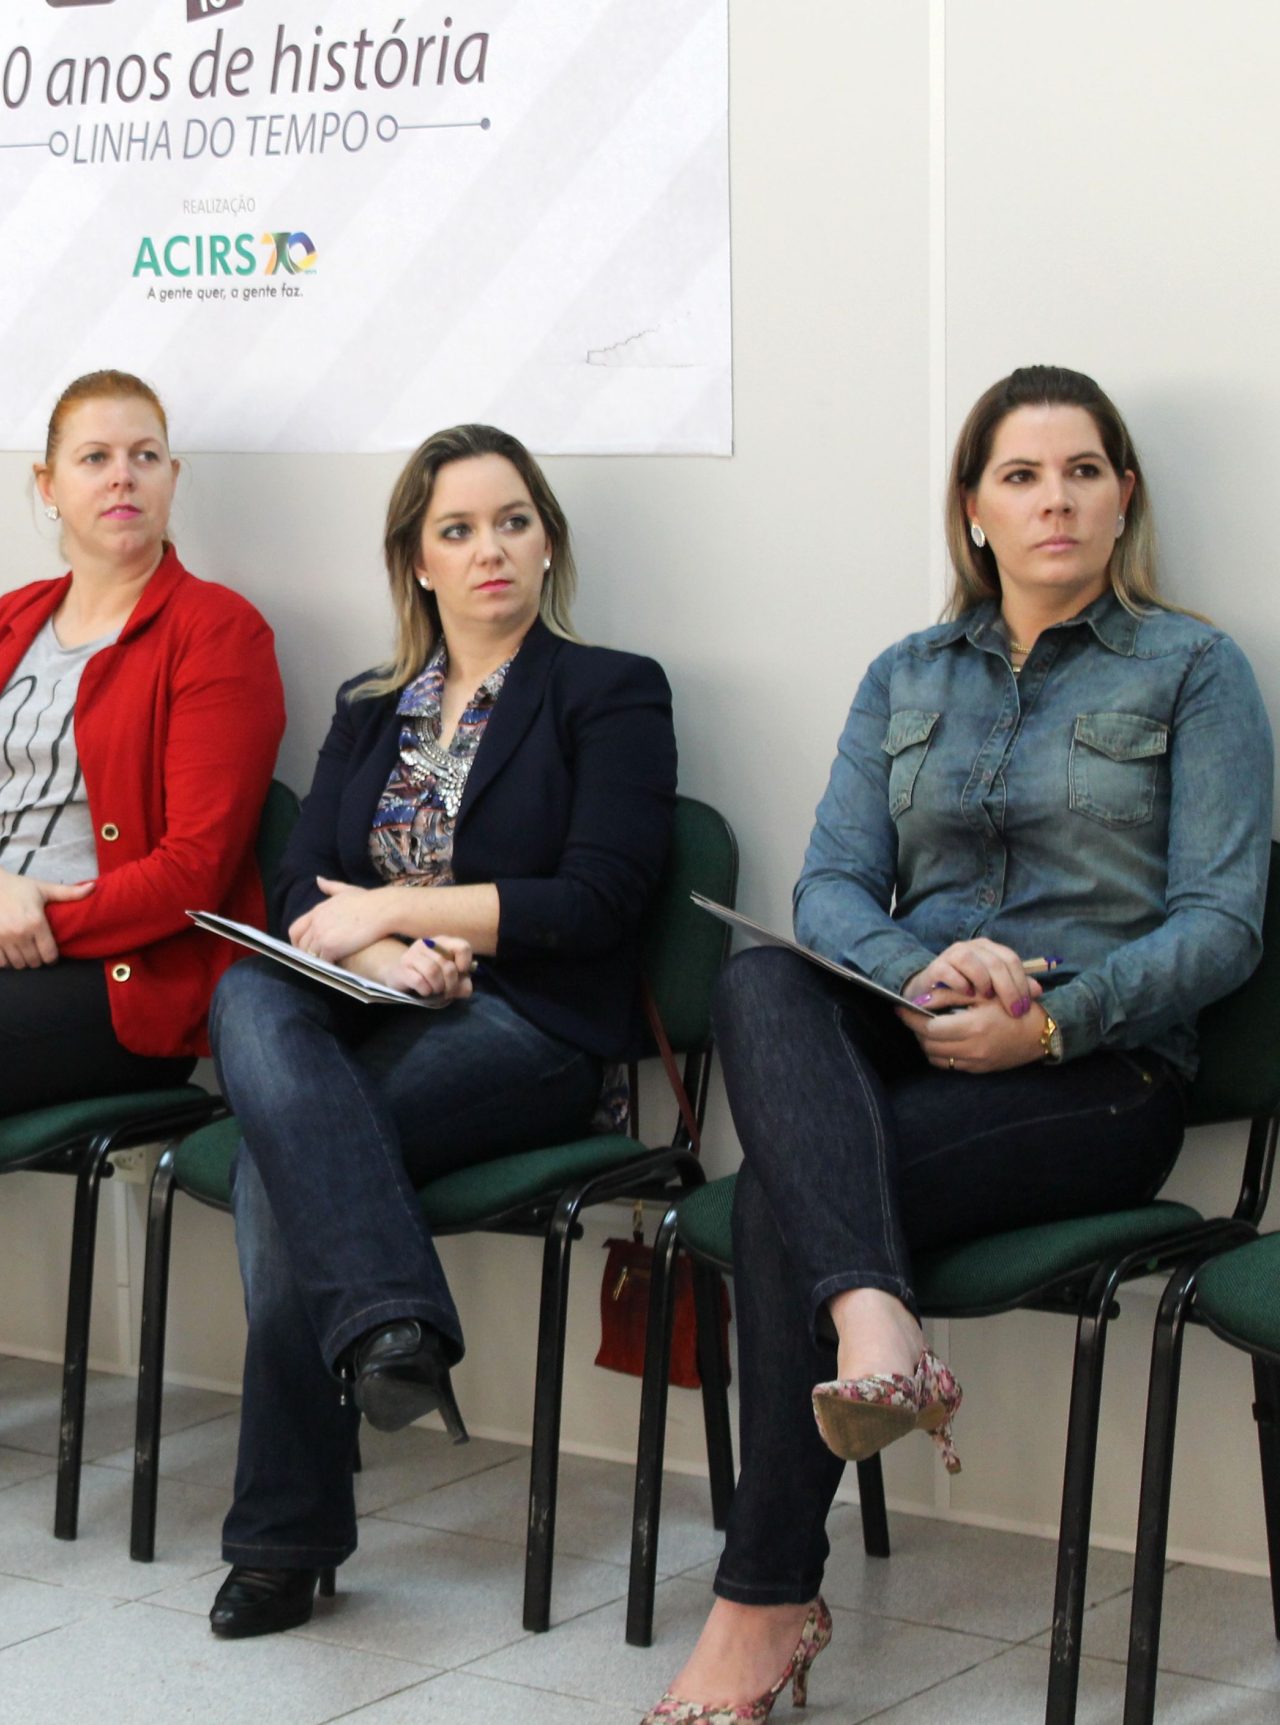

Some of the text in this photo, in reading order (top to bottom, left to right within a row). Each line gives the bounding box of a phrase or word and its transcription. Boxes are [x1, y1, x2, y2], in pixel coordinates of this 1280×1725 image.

[45, 51, 173, 108] anos
[187, 27, 255, 100] de
[269, 16, 490, 95] história
[72, 109, 370, 164] LINHA DO TEMPO
[182, 194, 256, 217] REALIZAÇÃO
[131, 232, 257, 278] ACIRS
[147, 282, 304, 303] A gente quer, a gente faz.
